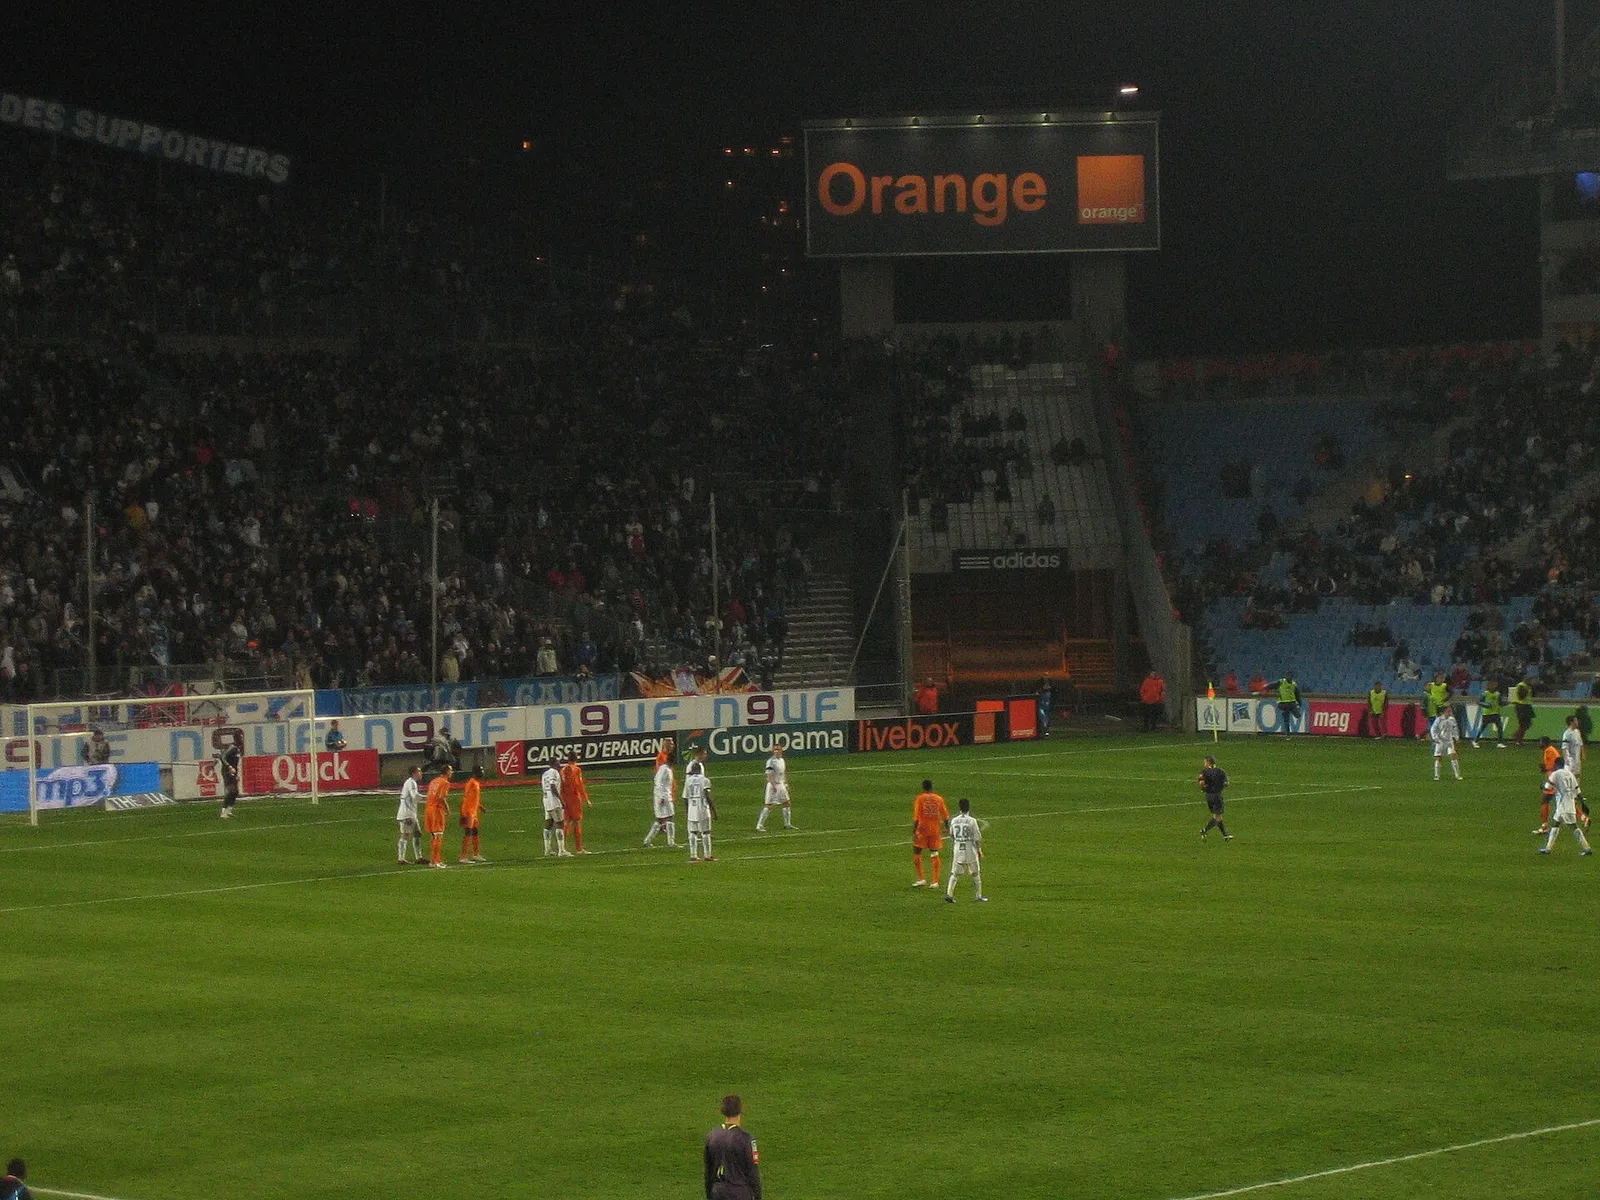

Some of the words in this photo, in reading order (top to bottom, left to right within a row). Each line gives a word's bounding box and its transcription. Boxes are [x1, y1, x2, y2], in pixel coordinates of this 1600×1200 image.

[73, 109, 291, 184] SUPPORTERS
[818, 162, 1049, 226] Orange
[1081, 204, 1138, 222] orange
[993, 552, 1061, 569] adidas
[858, 717, 960, 751] livebox
[1314, 711, 1350, 733] mag
[526, 743, 582, 763] CAISSE
[709, 728, 844, 756] Groupama
[36, 768, 105, 806] mp3
